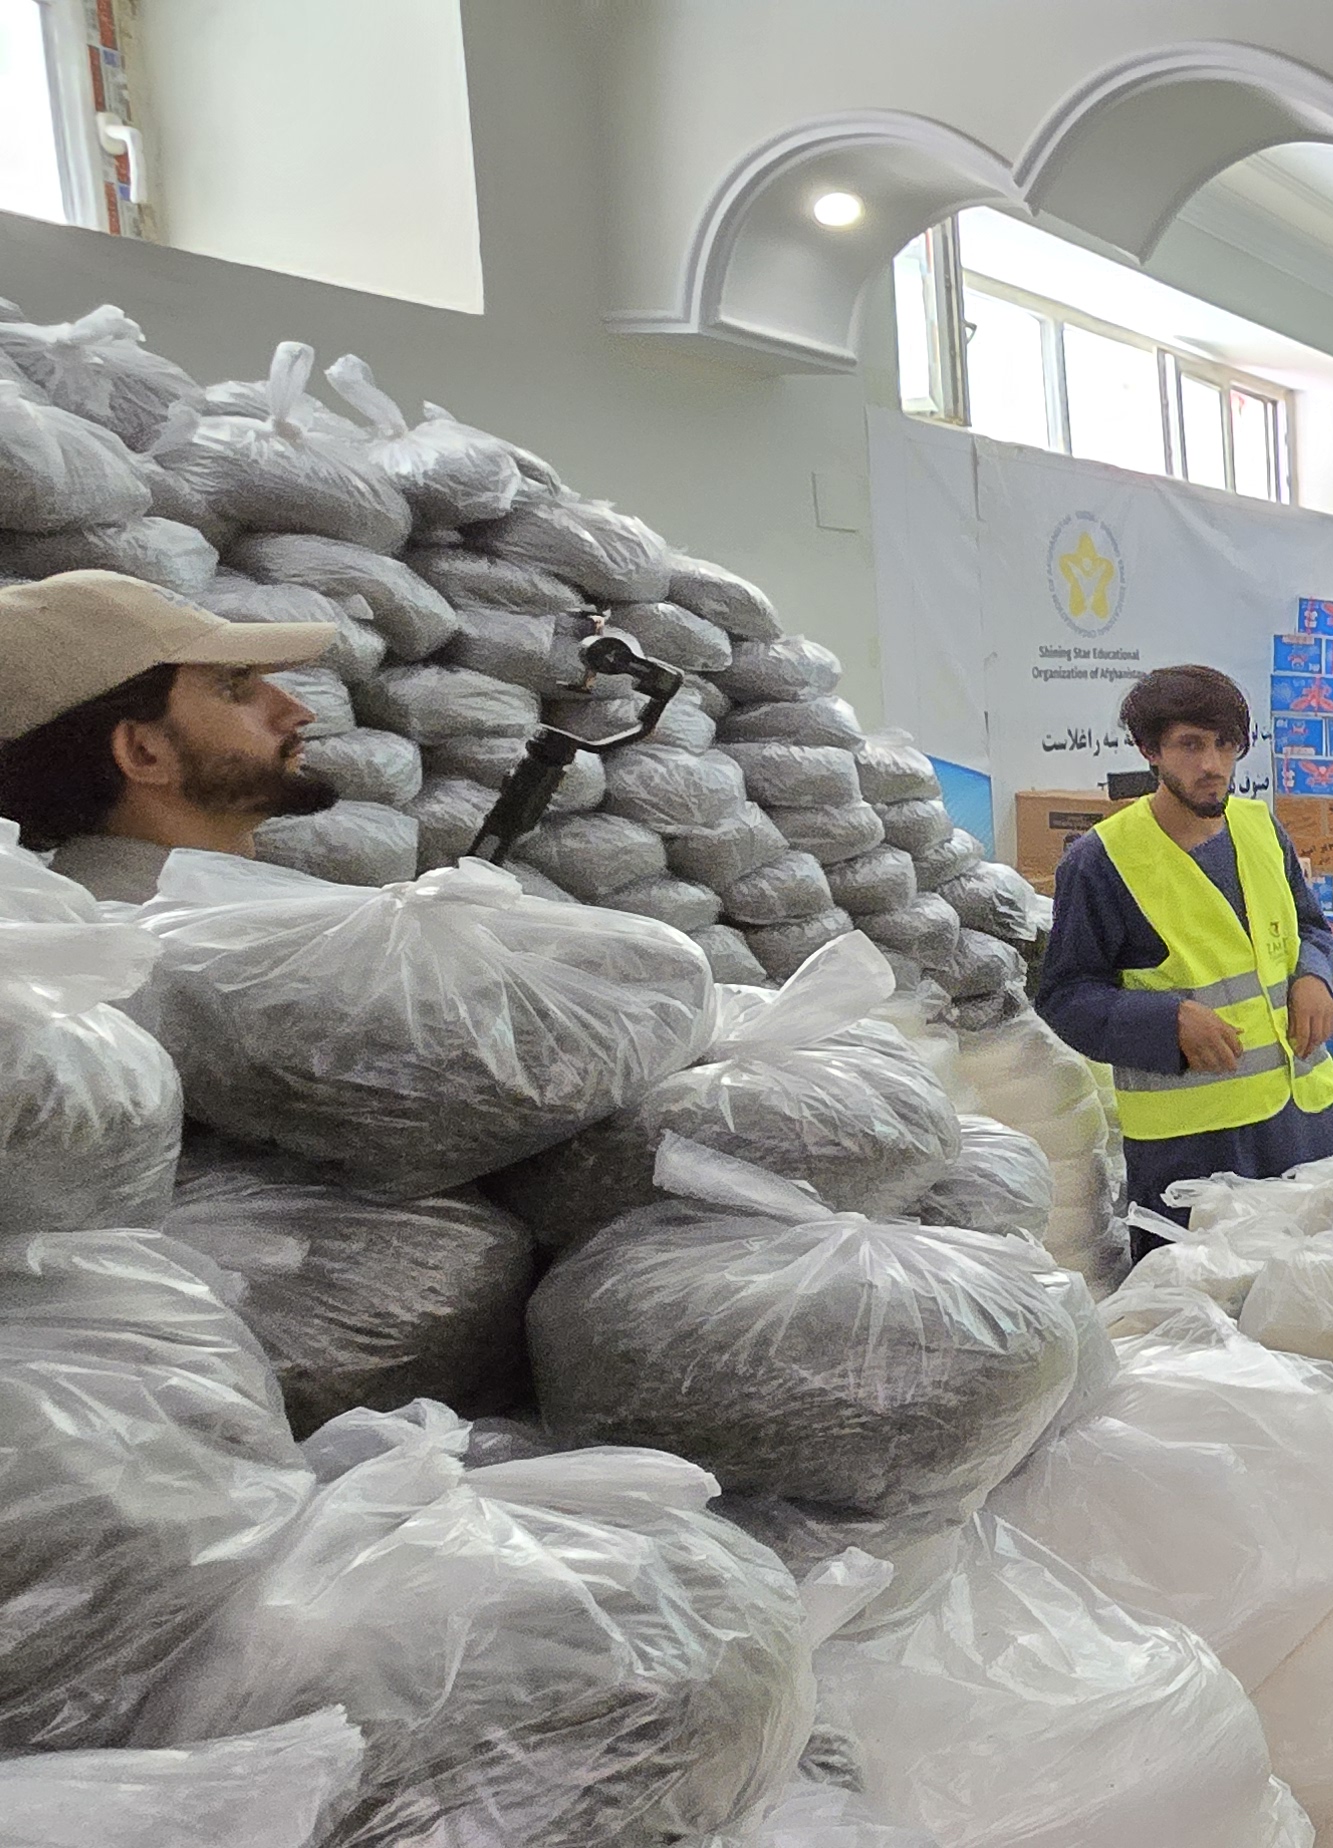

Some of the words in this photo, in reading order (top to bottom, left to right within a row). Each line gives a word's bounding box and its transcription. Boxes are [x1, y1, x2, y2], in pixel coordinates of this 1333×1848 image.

[1038, 645, 1072, 662] Shining
[1073, 647, 1091, 660] Star
[1092, 647, 1140, 661] Educational
[1032, 666, 1088, 682] Organization
[1090, 667, 1099, 680] of
